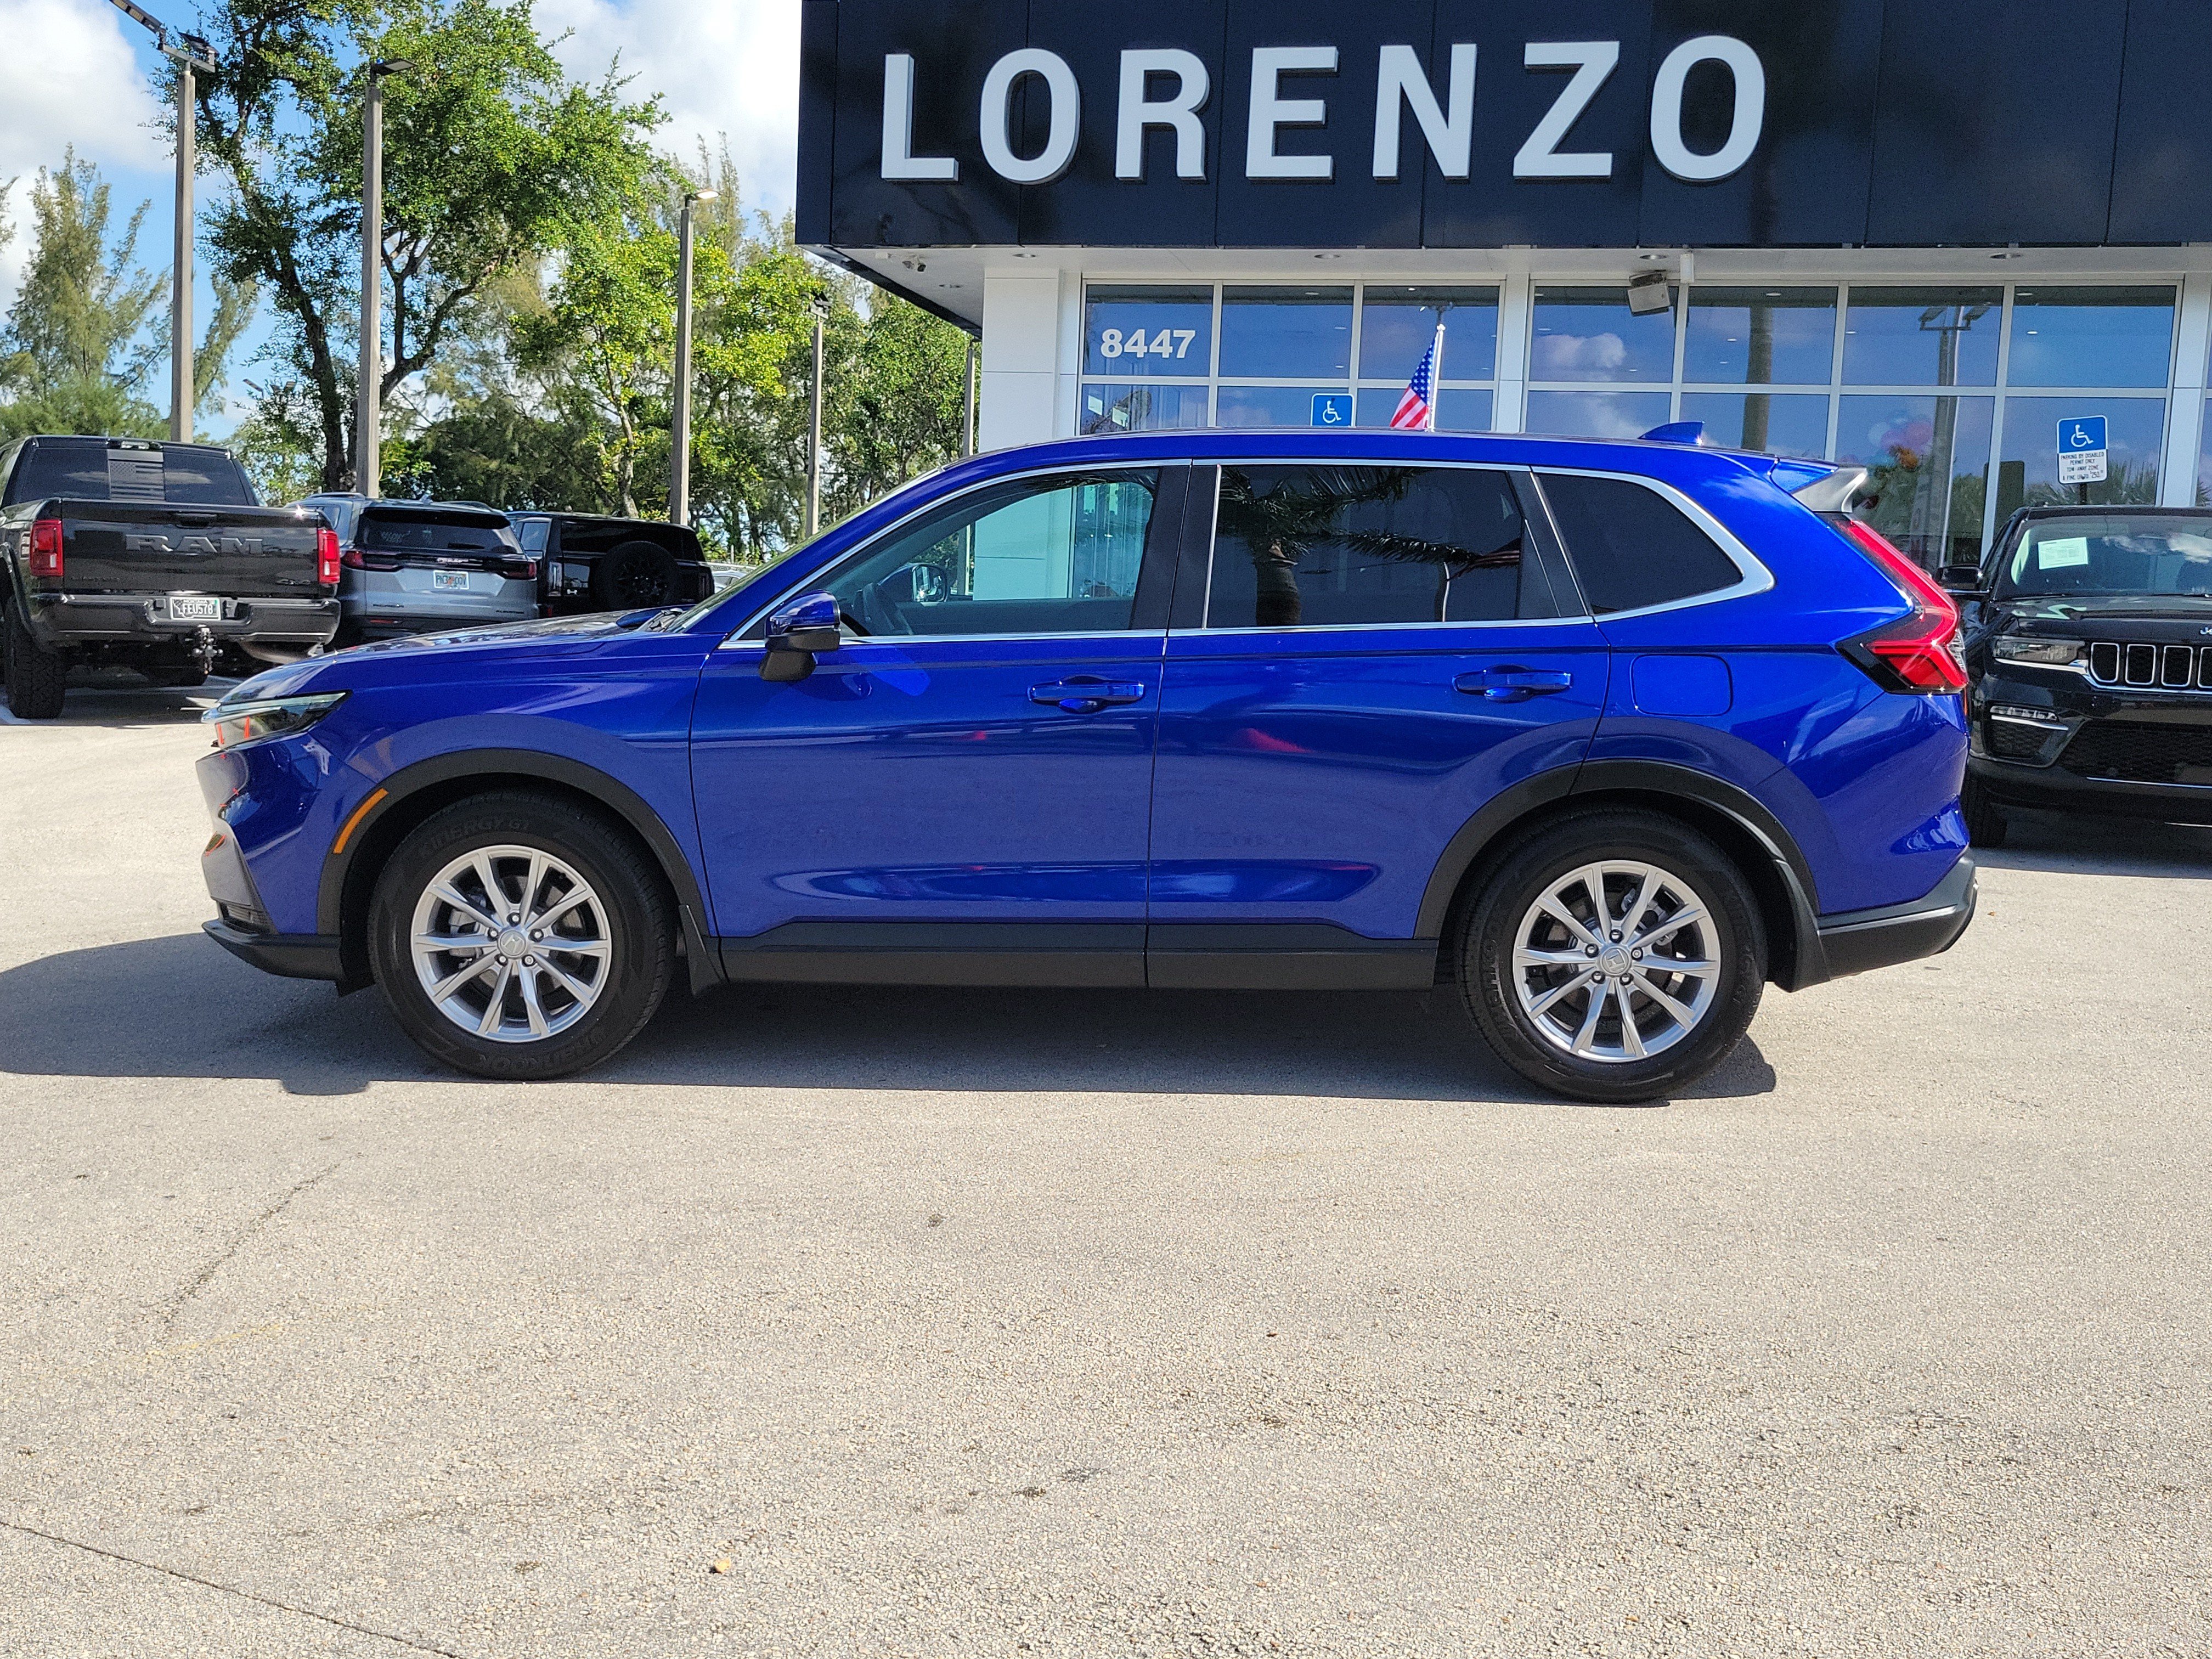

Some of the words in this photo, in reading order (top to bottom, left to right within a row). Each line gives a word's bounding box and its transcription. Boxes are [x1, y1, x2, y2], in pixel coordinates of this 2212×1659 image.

[881, 35, 1765, 185] LORENZO
[1101, 329, 1196, 358] 8447
[126, 534, 263, 553] RAM
